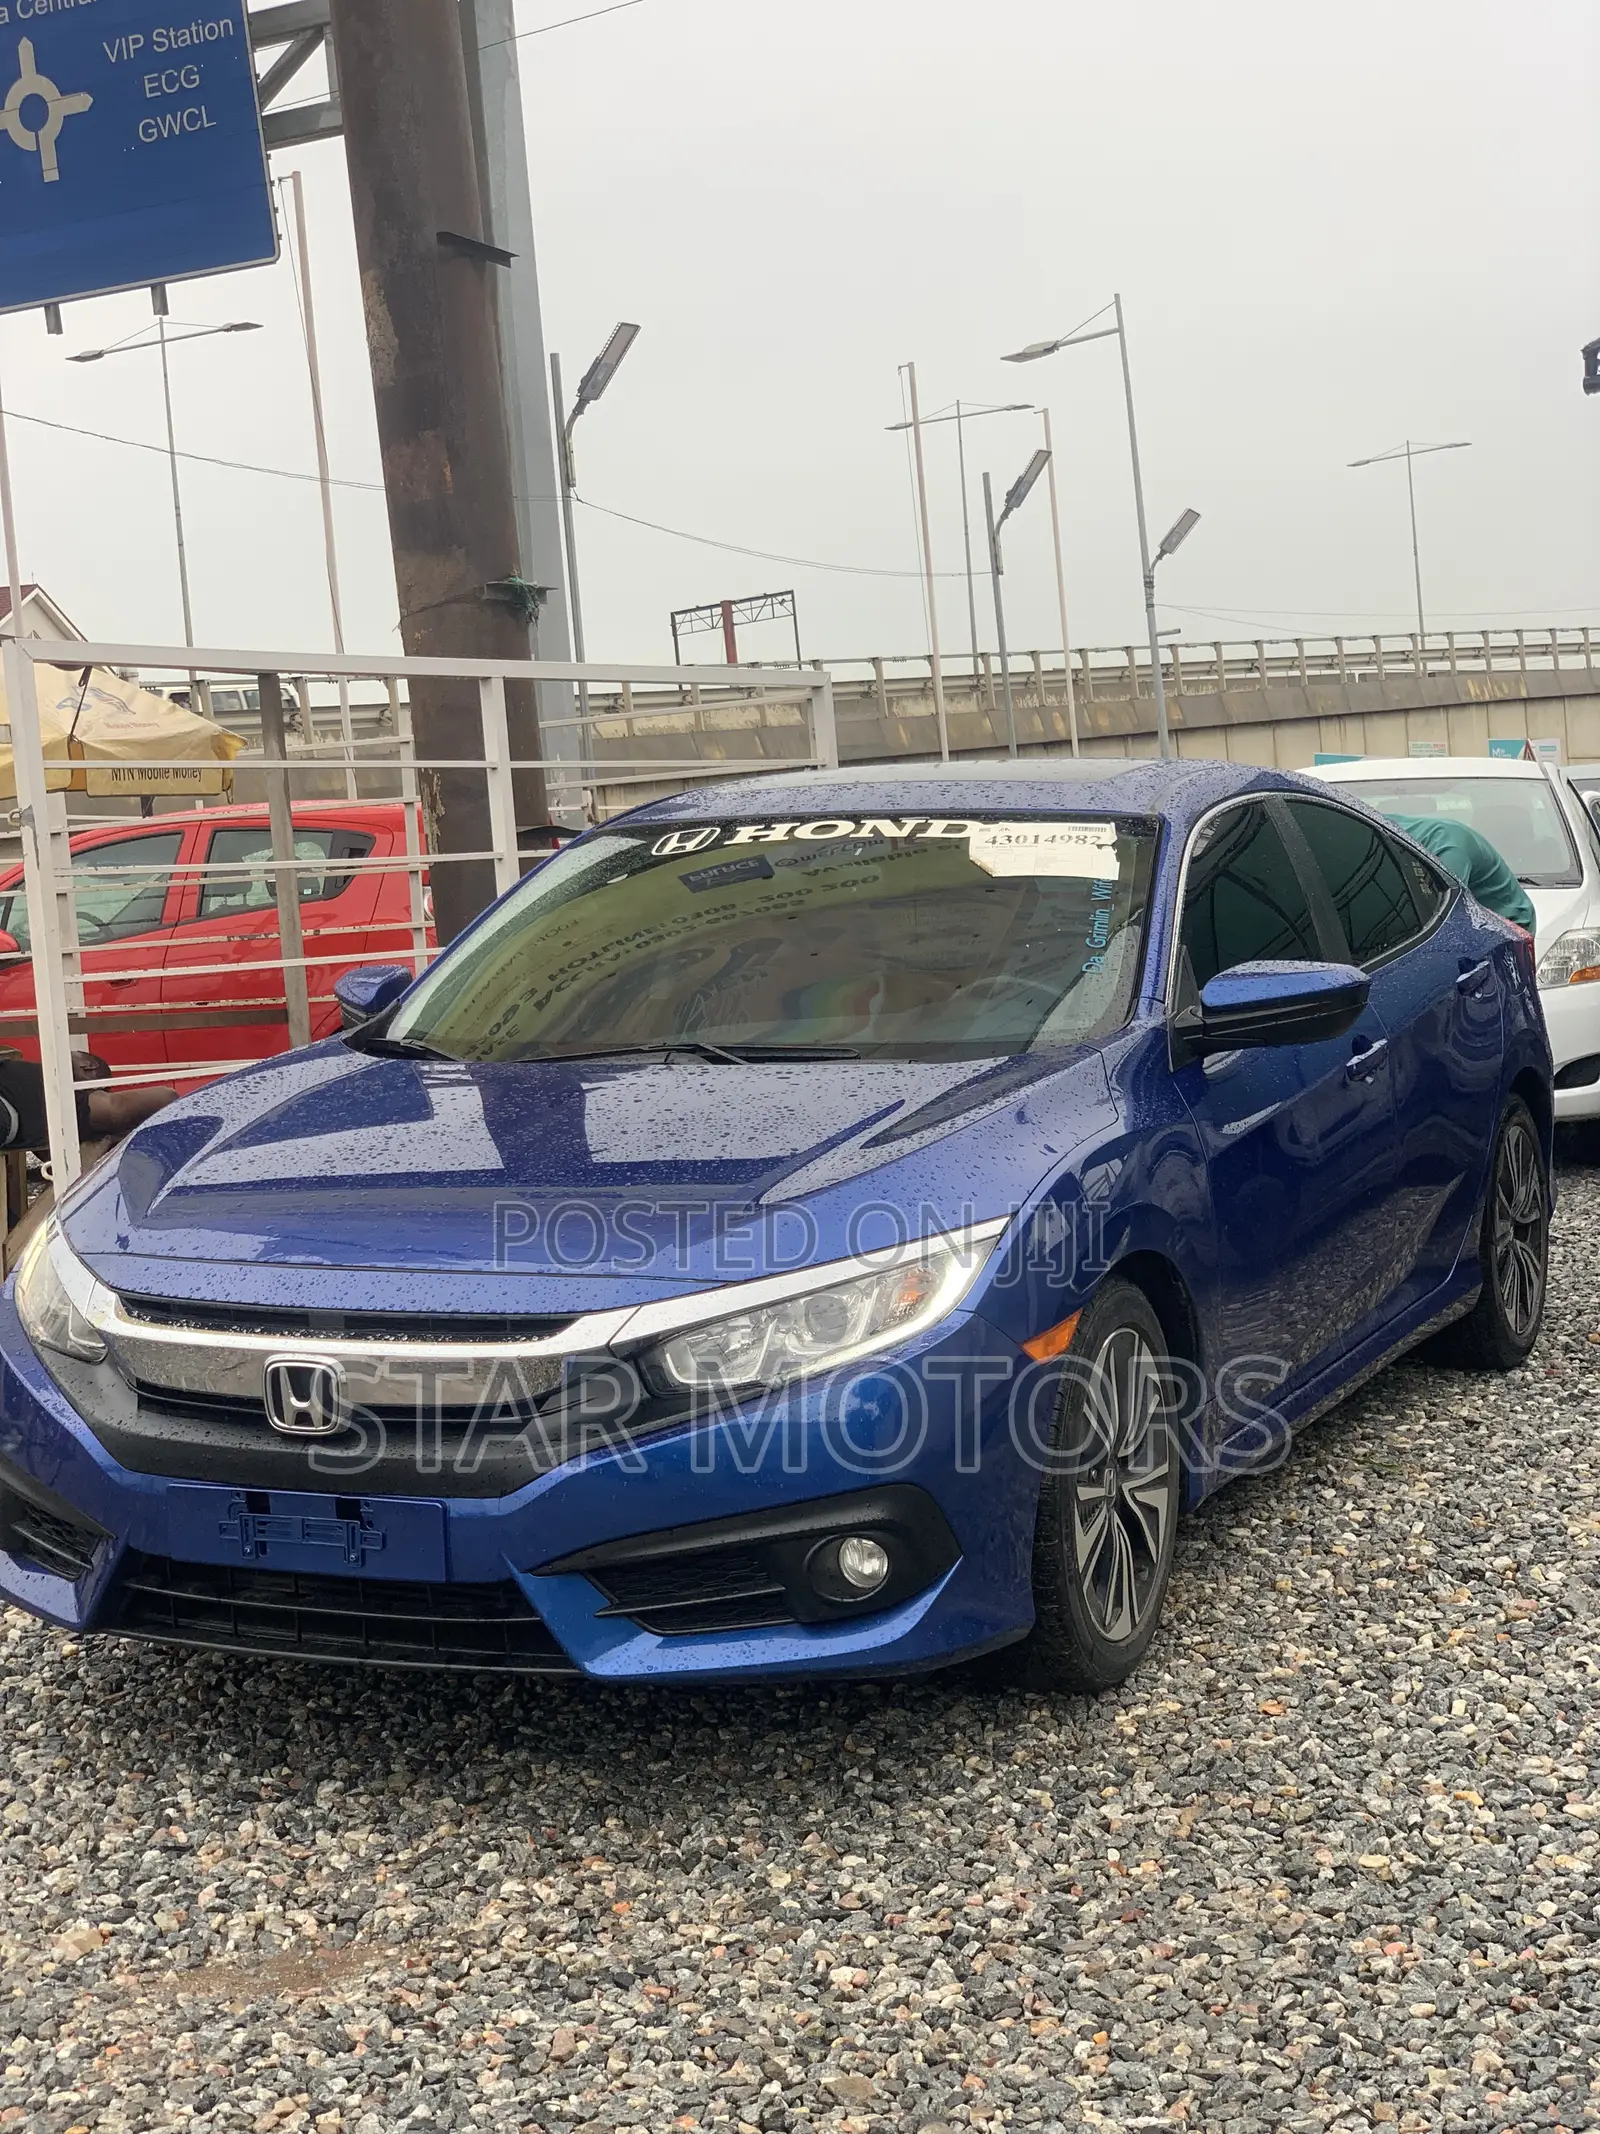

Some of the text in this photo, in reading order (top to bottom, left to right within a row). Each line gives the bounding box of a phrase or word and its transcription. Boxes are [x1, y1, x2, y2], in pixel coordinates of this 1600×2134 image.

[16, 0, 97, 19] Cent
[103, 18, 234, 63] VIP Station
[143, 64, 200, 98] ECG
[138, 105, 216, 142] GWCL
[724, 818, 976, 845] HOND
